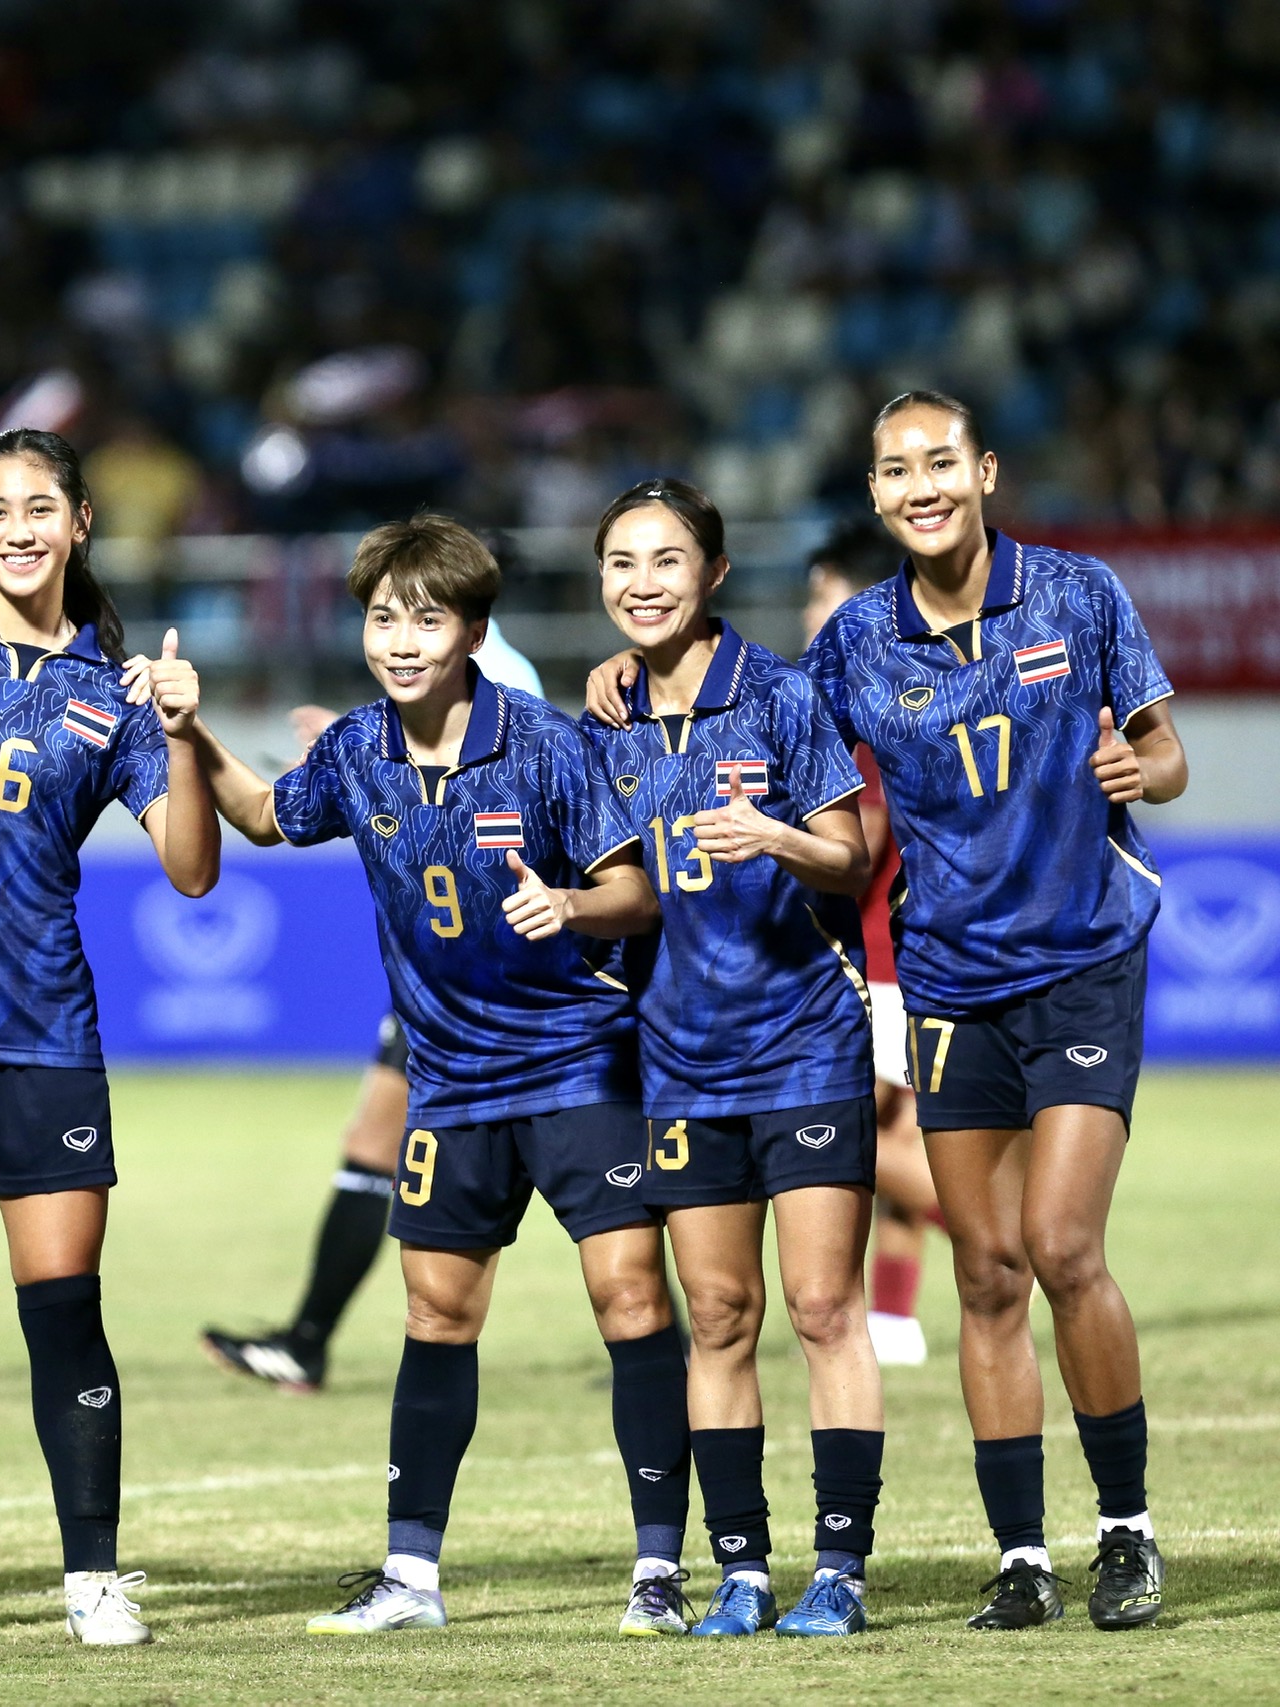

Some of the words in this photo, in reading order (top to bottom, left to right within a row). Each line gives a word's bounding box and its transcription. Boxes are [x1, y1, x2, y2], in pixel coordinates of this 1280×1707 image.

[948, 714, 1012, 798] 17
[648, 814, 713, 893] 13
[423, 865, 463, 938] 9
[400, 1128, 438, 1207] 9
